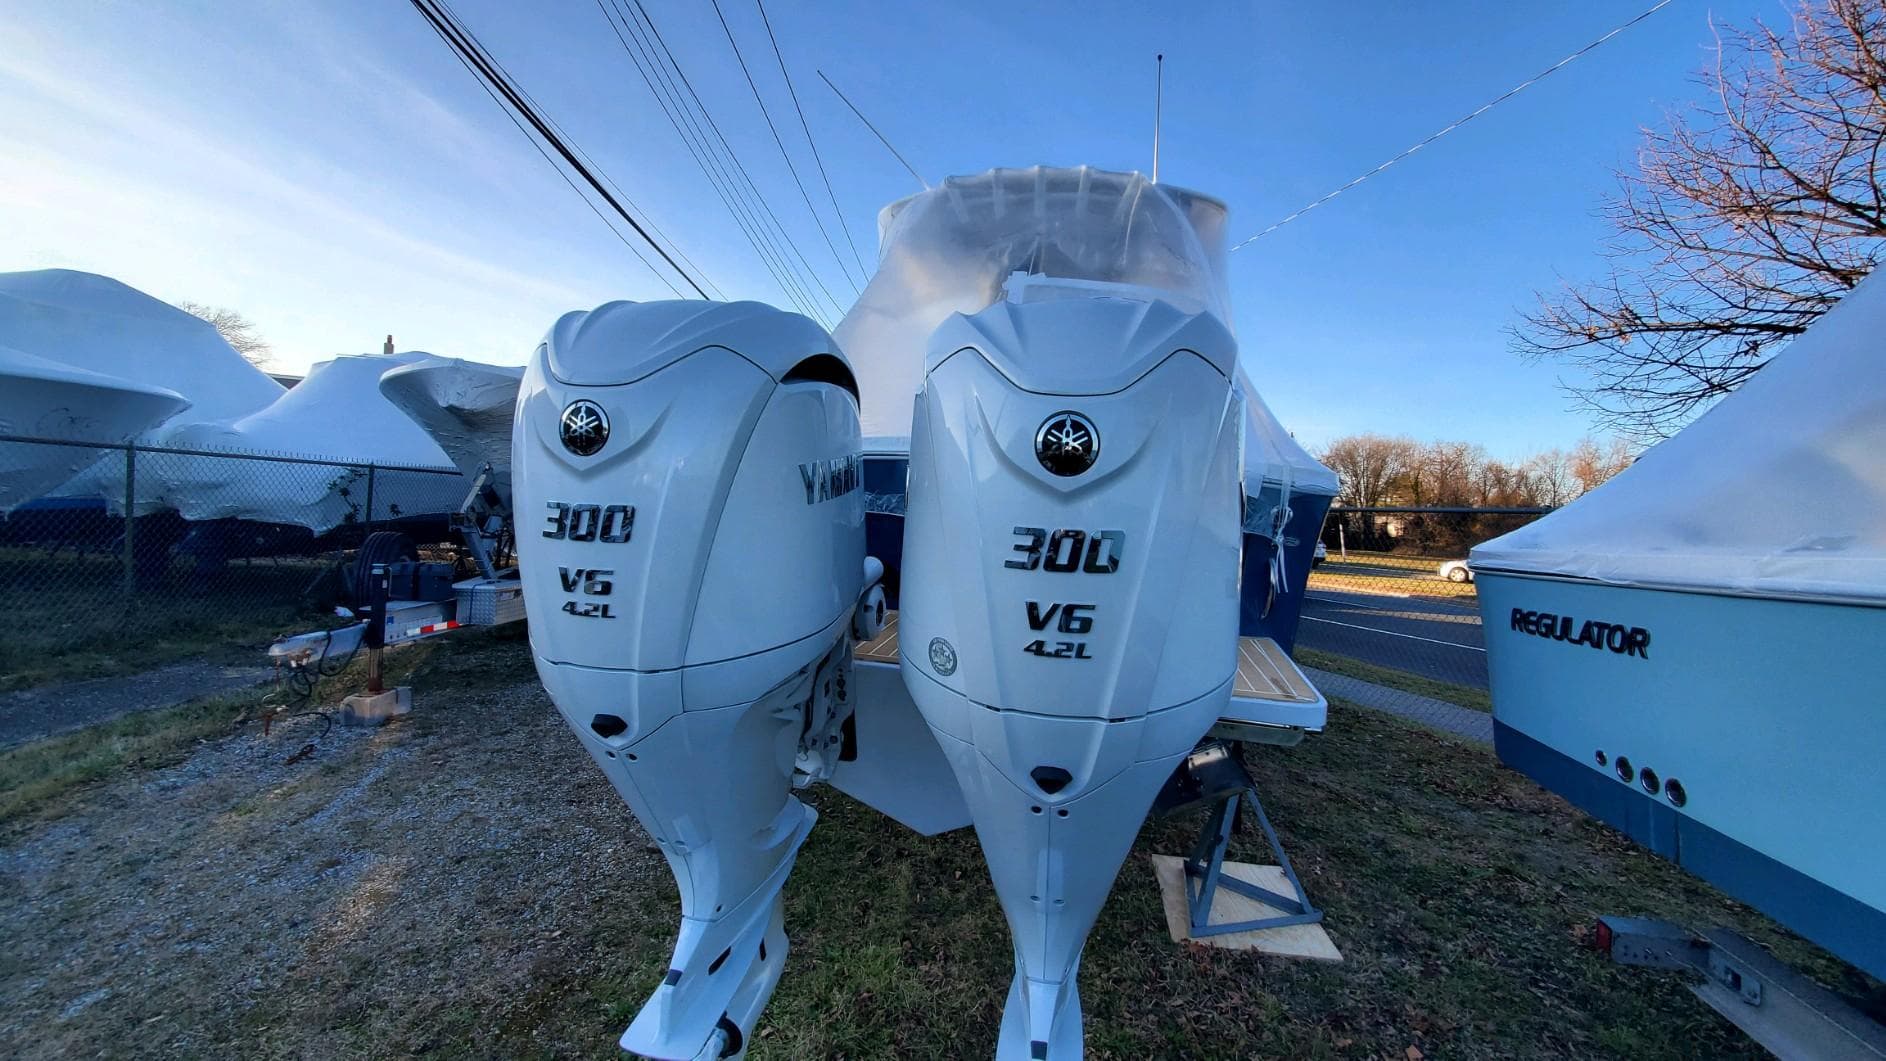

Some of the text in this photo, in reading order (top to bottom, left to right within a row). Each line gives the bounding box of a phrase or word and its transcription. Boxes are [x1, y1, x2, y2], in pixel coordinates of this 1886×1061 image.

[542, 501, 635, 543] 300
[1004, 526, 1126, 573] 300
[558, 566, 614, 596] V6
[562, 601, 616, 619] 4.2L
[1025, 601, 1096, 634] V6
[1023, 639, 1093, 659] 4.2L
[1510, 607, 1650, 660] REGULATOR
